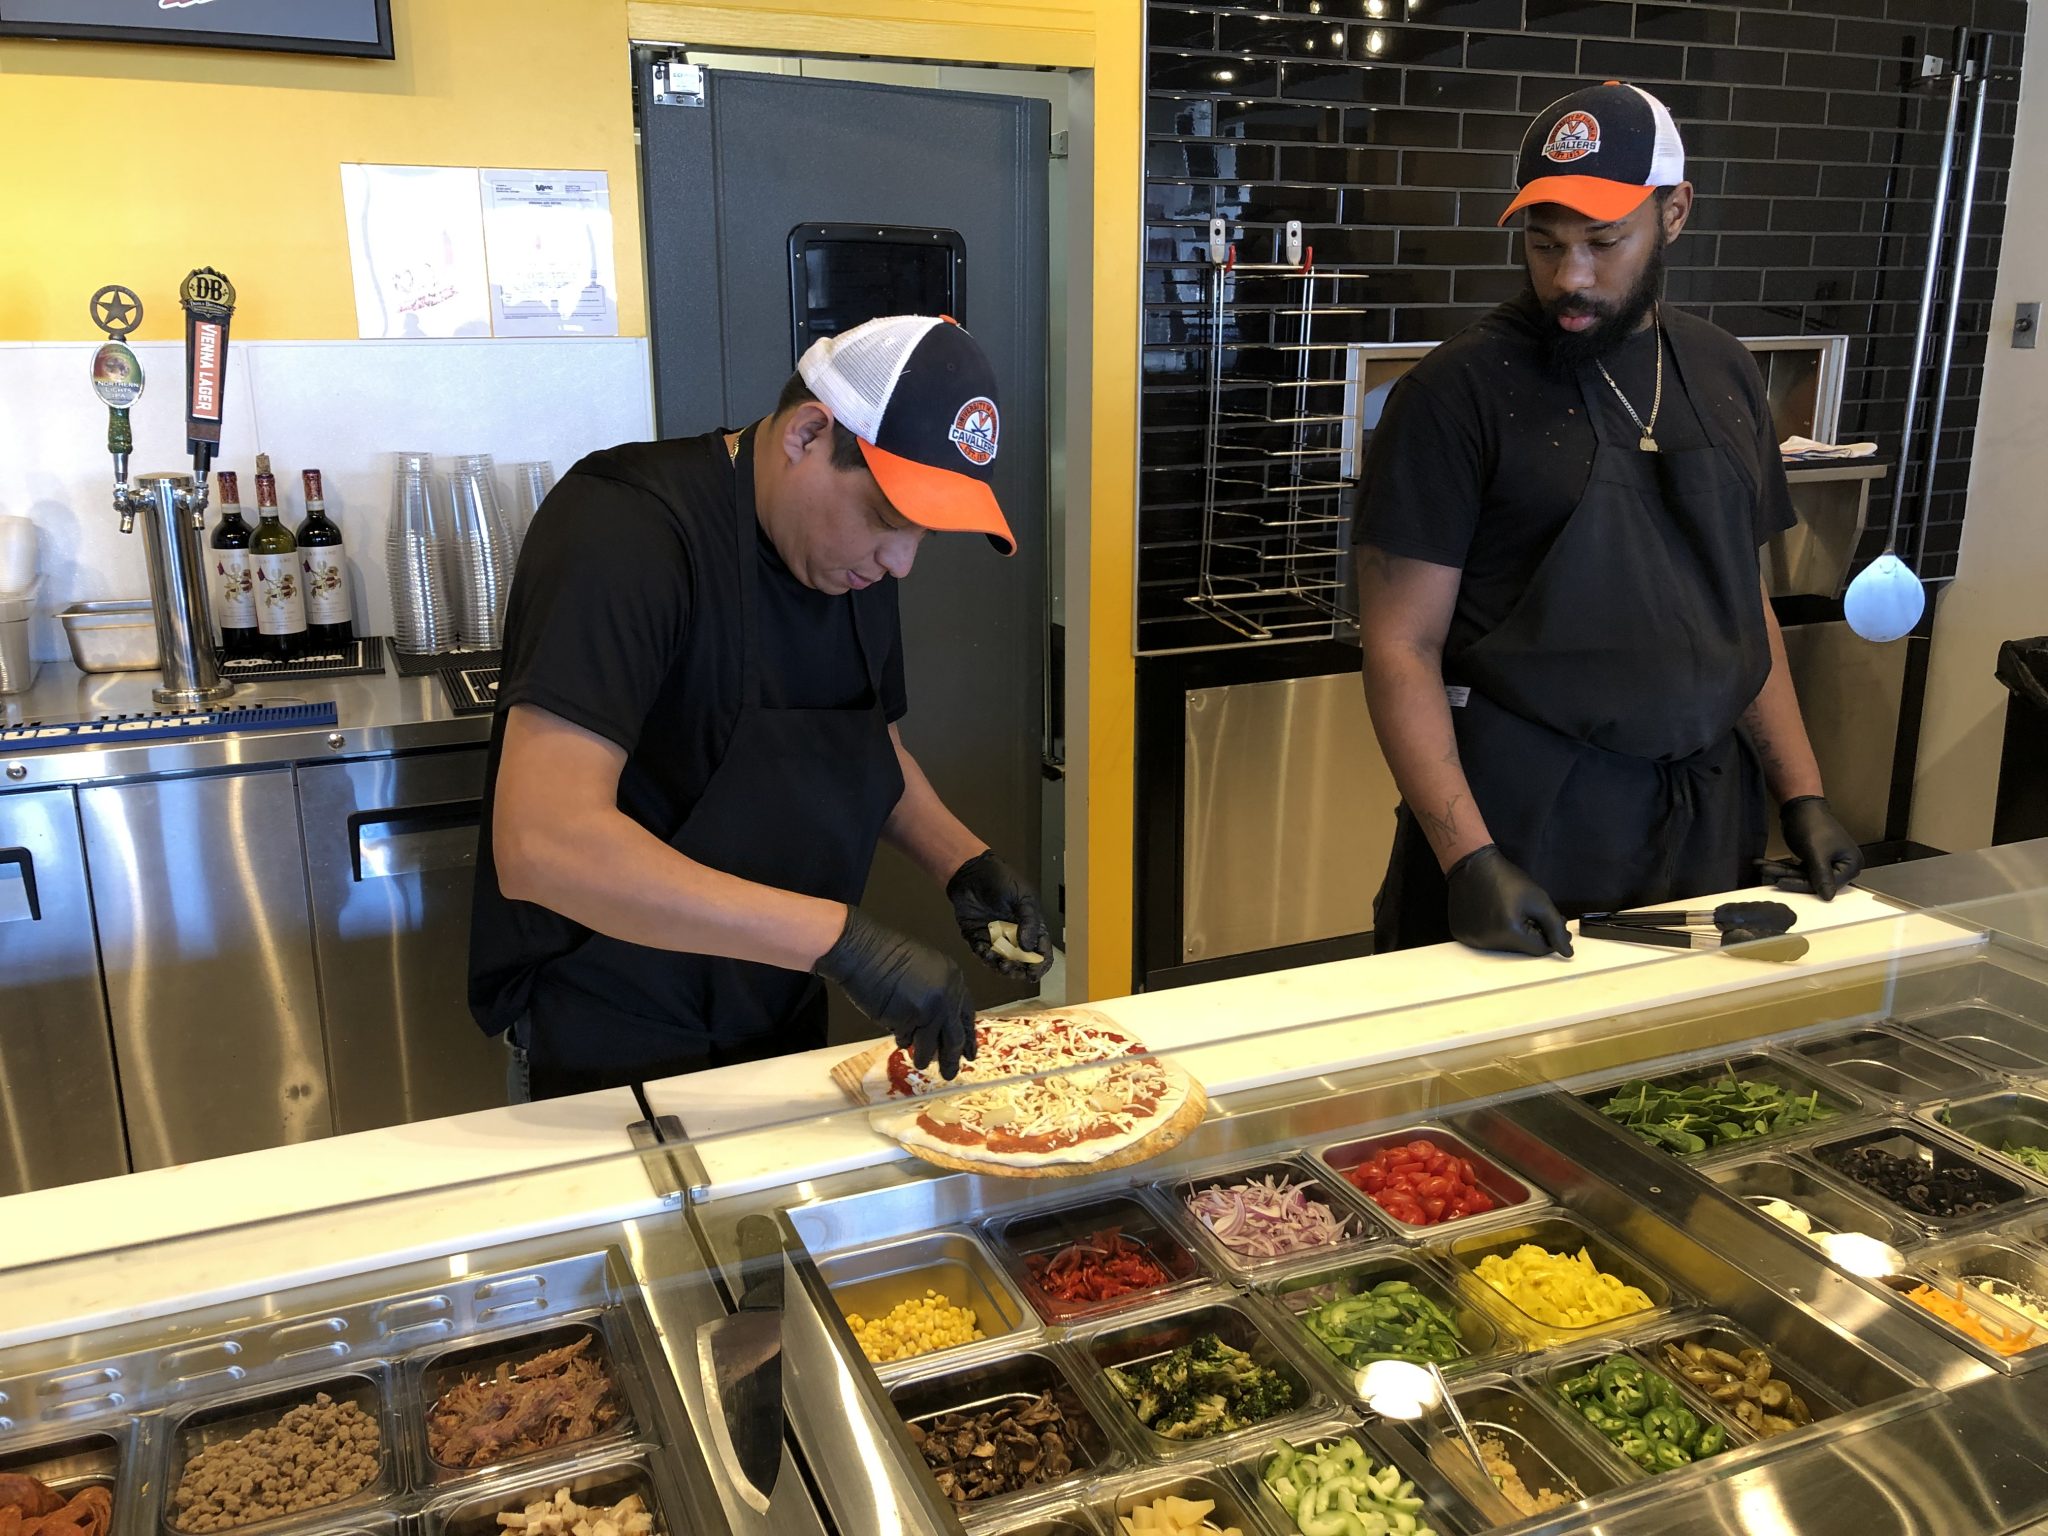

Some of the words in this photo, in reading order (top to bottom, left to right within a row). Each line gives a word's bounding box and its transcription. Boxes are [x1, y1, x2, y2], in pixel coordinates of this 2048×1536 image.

[1544, 140, 1598, 153] CAVALIERS
[196, 276, 222, 301] DB
[199, 324, 216, 369] VIENNA
[97, 380, 140, 388] NORTHERN
[105, 386, 132, 394] LIGHTS
[195, 371, 214, 411] LAGER
[951, 429, 995, 456] CAVALIERS
[0, 728, 71, 741] UD
[77, 716, 211, 735] LIGHT
